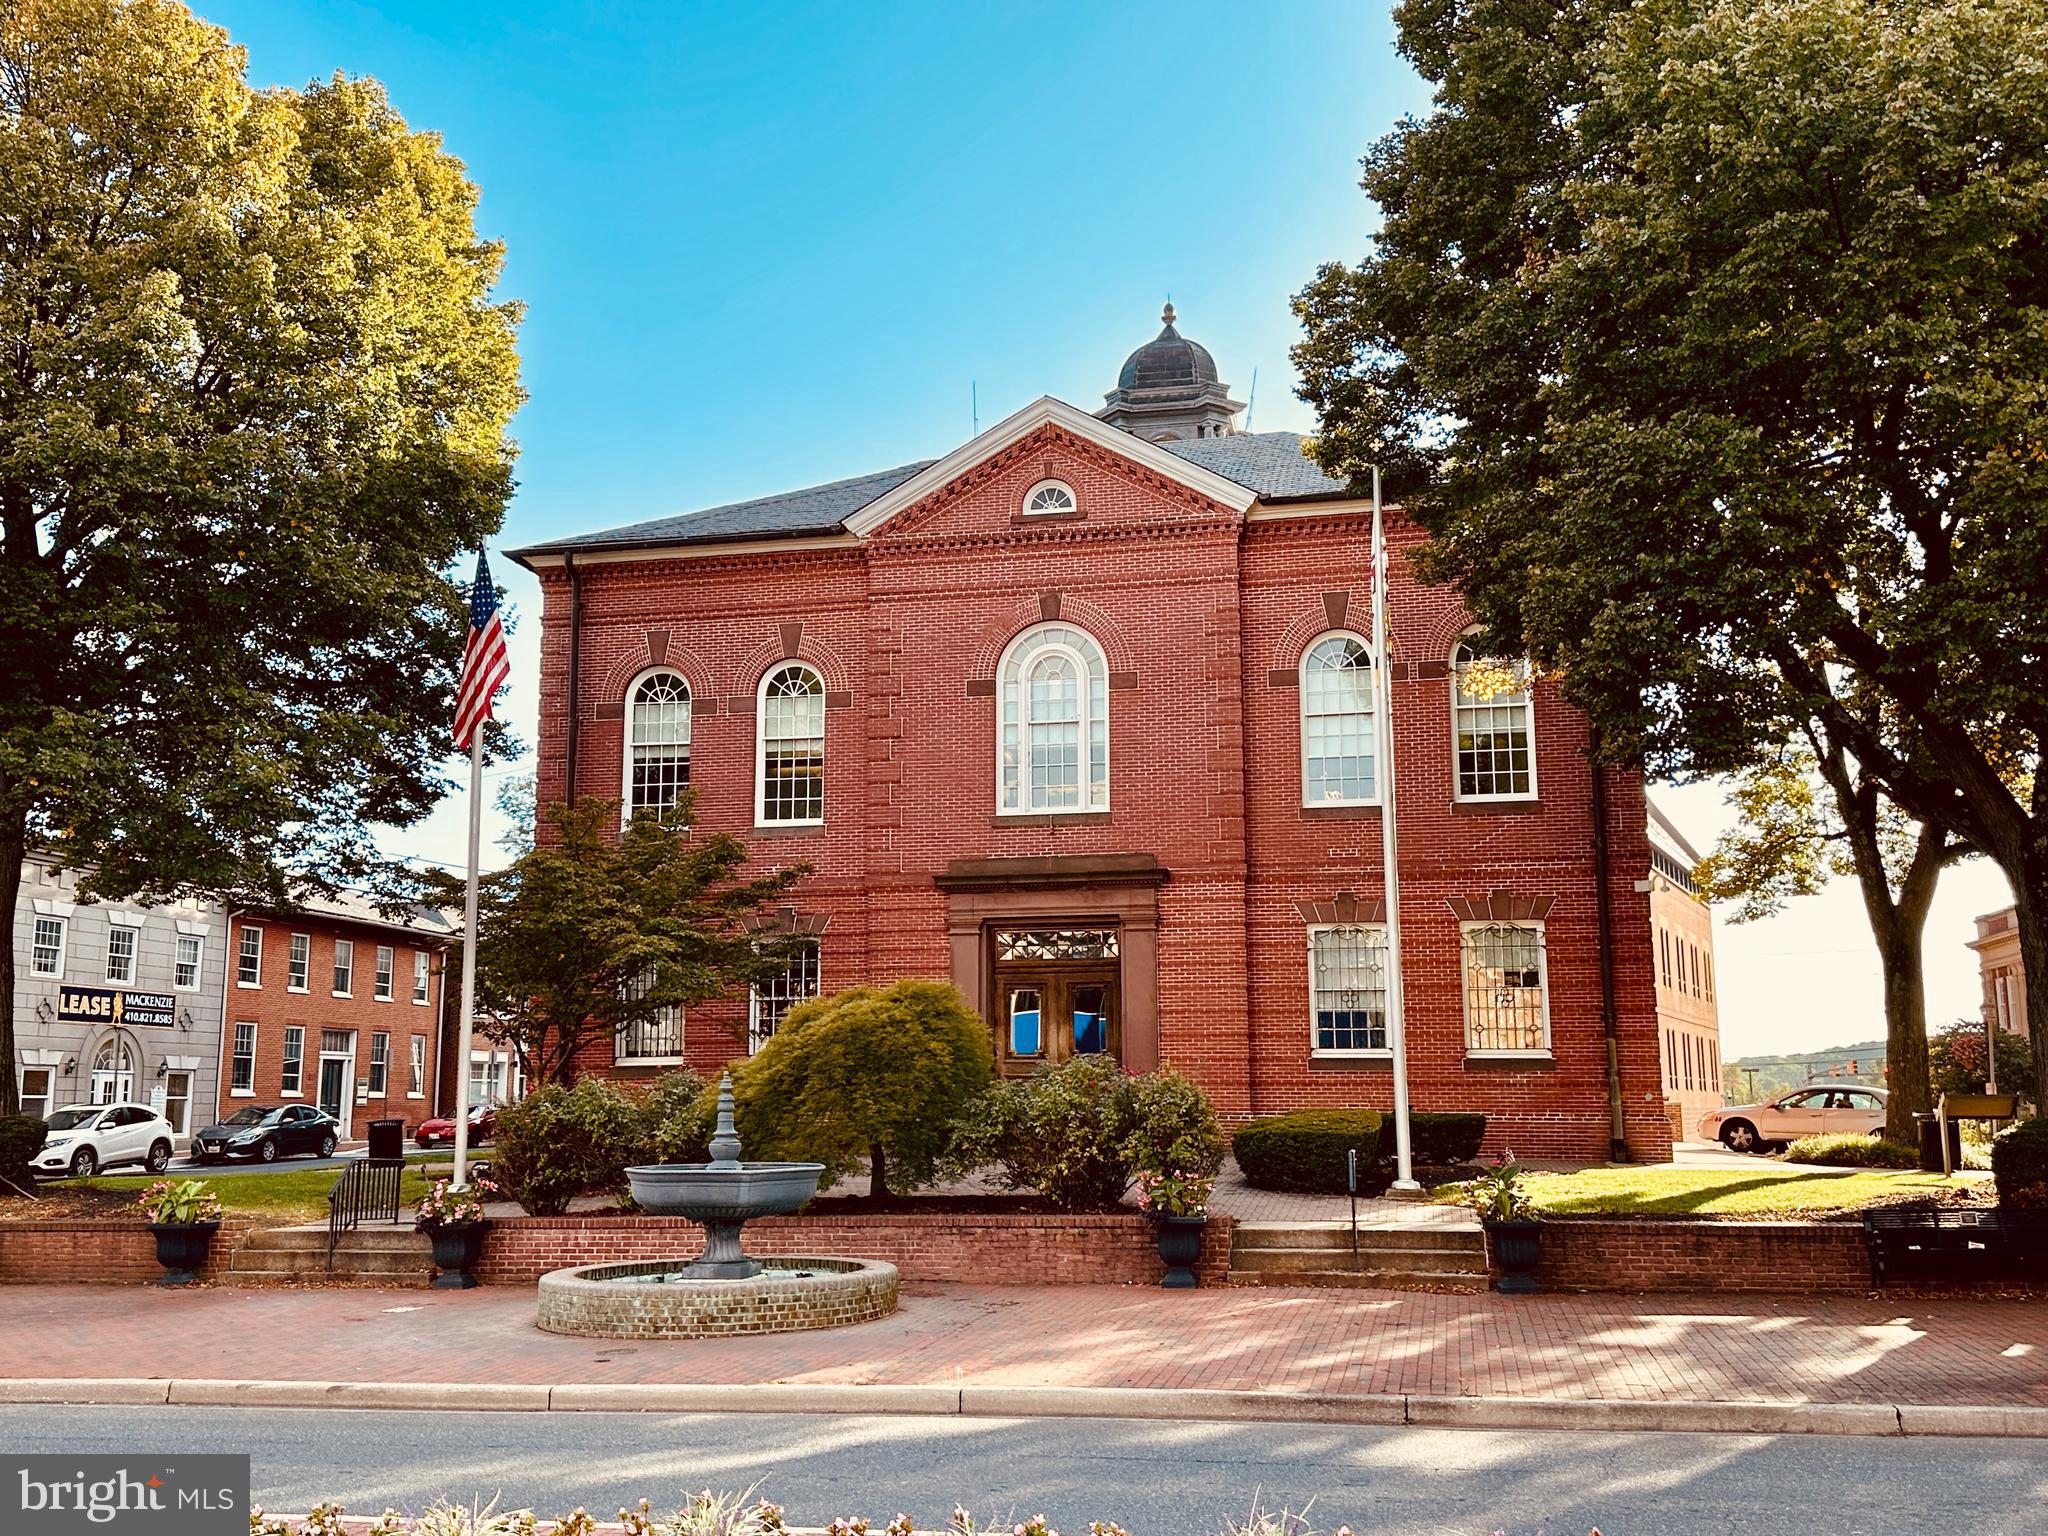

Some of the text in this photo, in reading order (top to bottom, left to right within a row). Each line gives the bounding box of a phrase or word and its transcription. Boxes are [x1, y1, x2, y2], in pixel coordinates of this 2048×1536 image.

[60, 994, 111, 1016] LEASE
[125, 994, 174, 1008] MACKENZIE
[124, 1011, 173, 1024] 410.821.8585
